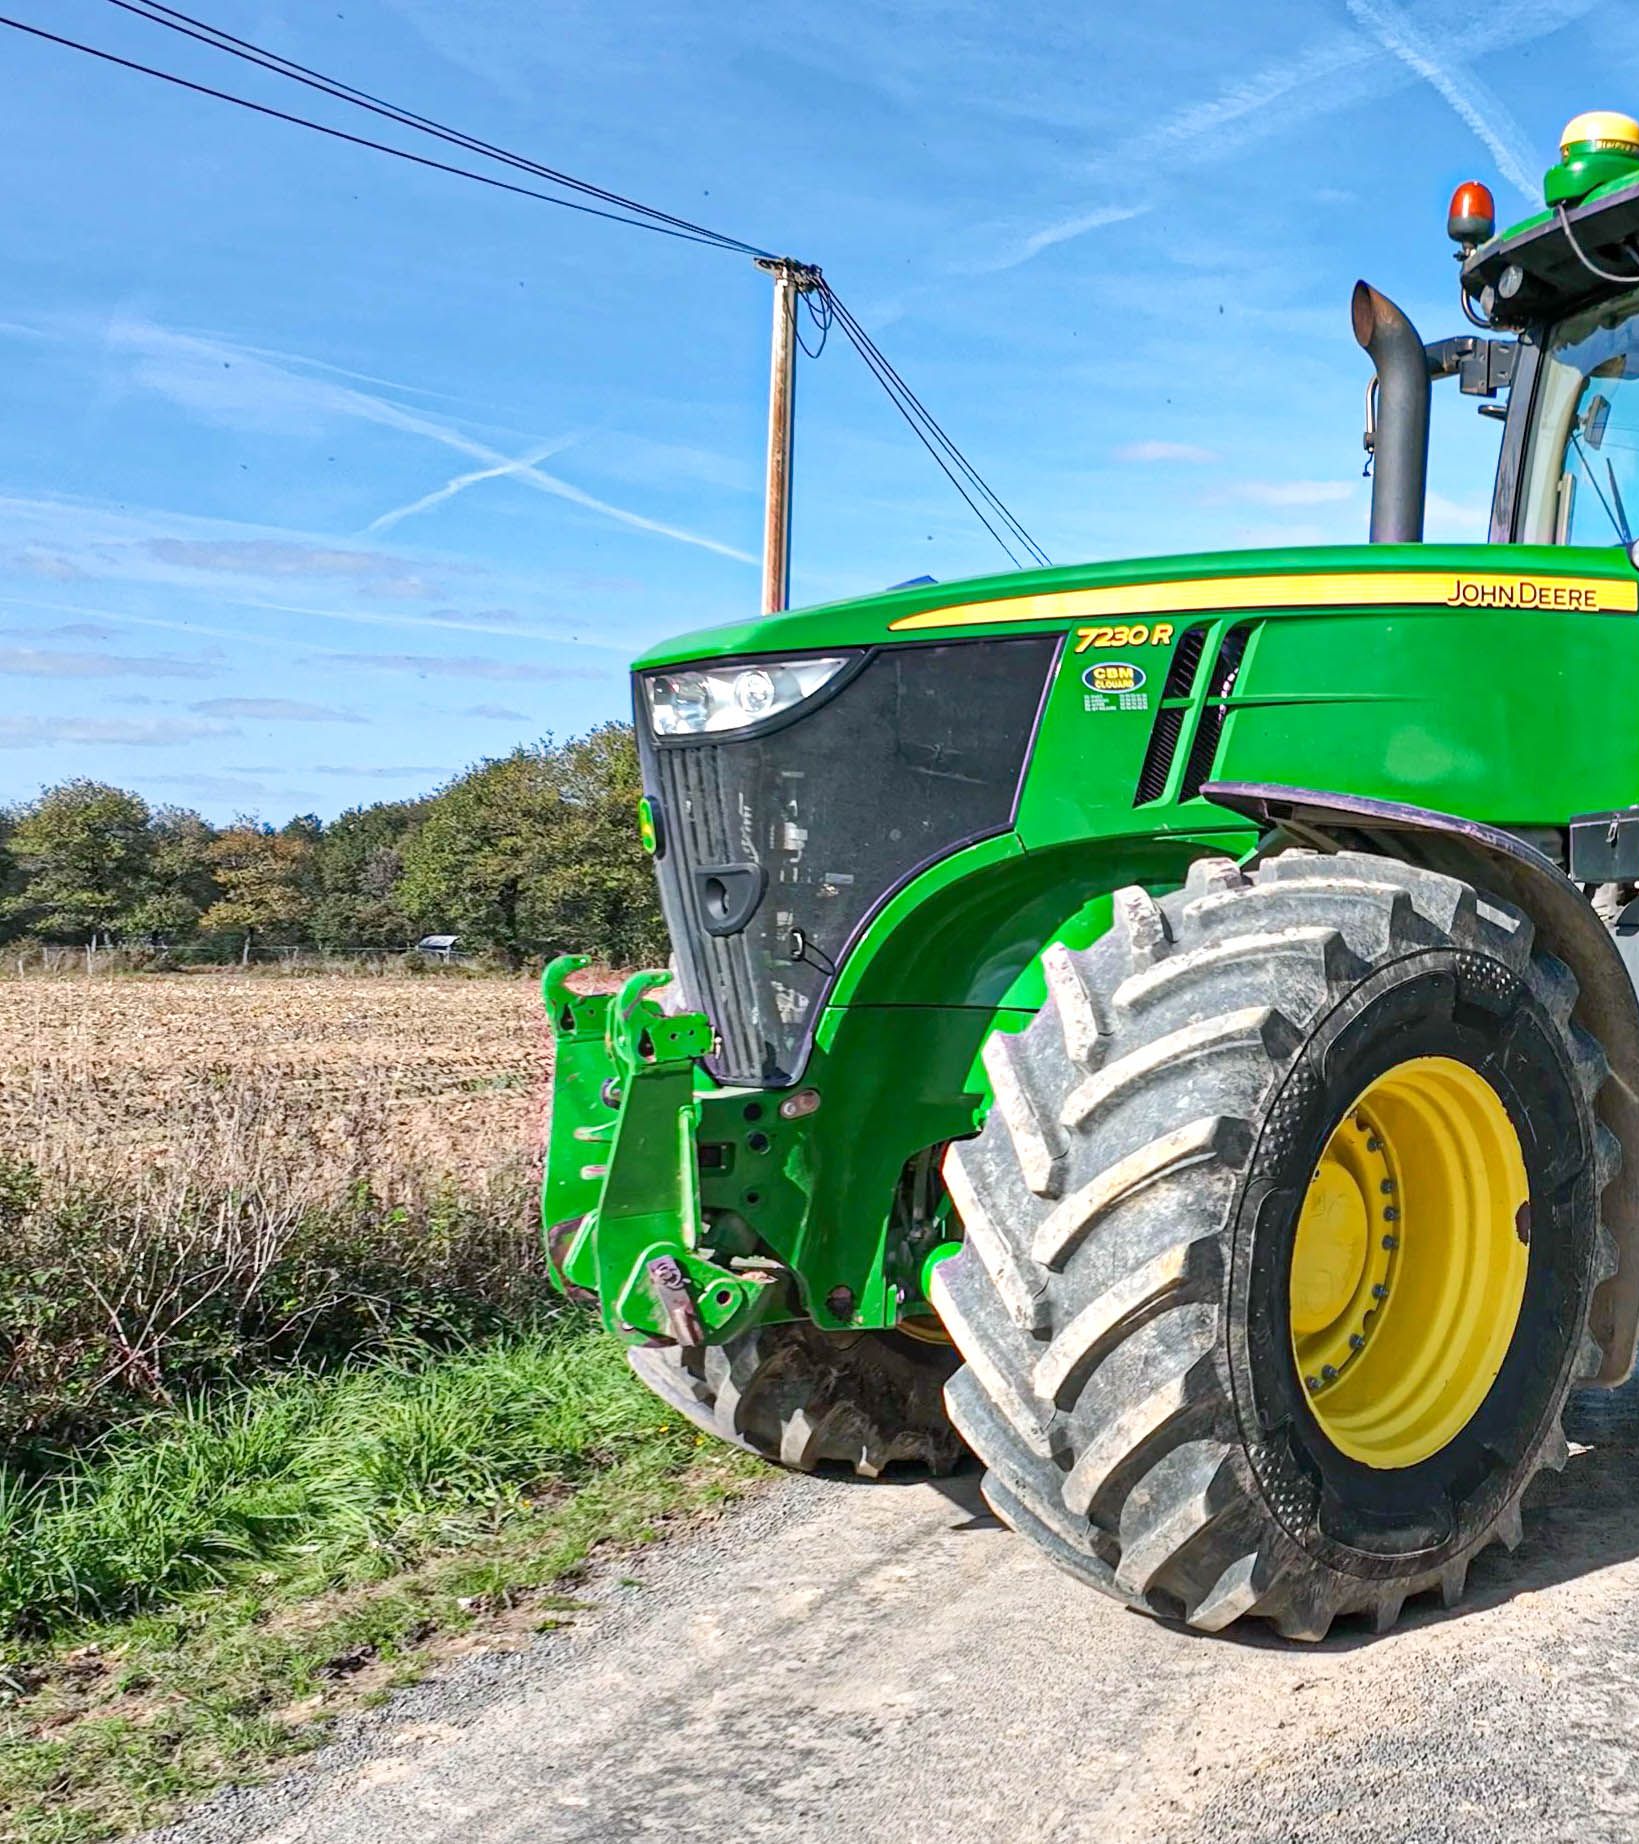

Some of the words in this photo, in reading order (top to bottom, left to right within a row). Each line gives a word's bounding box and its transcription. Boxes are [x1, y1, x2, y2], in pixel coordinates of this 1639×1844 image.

[1448, 580, 1514, 603] JOHN
[1519, 582, 1597, 607] DEERE
[1075, 625, 1149, 653] 7230
[1151, 624, 1174, 645] R
[1093, 668, 1134, 679] CBM
